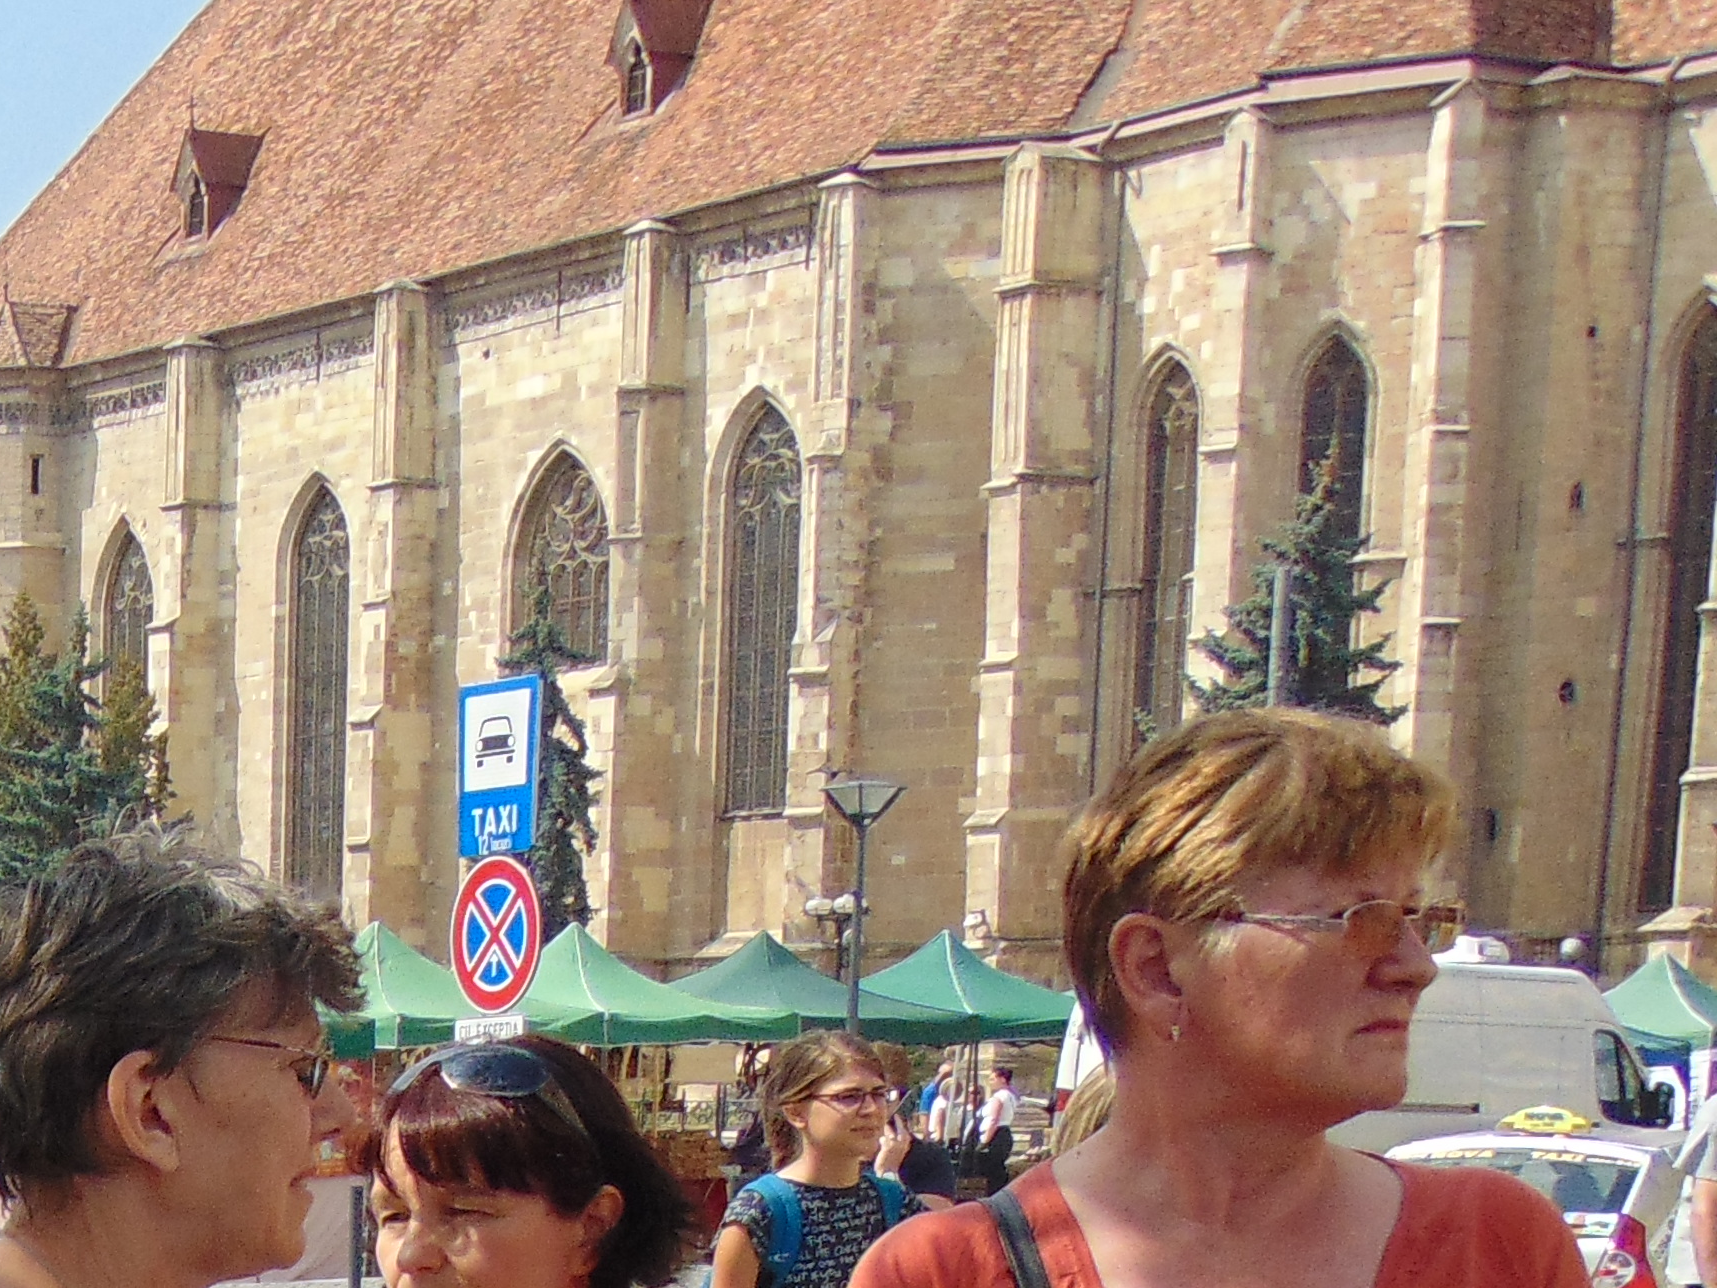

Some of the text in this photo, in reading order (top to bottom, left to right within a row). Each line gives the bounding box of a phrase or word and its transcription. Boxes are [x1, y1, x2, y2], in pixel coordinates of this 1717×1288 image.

[471, 803, 518, 838] TAXI
[478, 835, 489, 856] 12
[1530, 1150, 1586, 1163] TAXI
